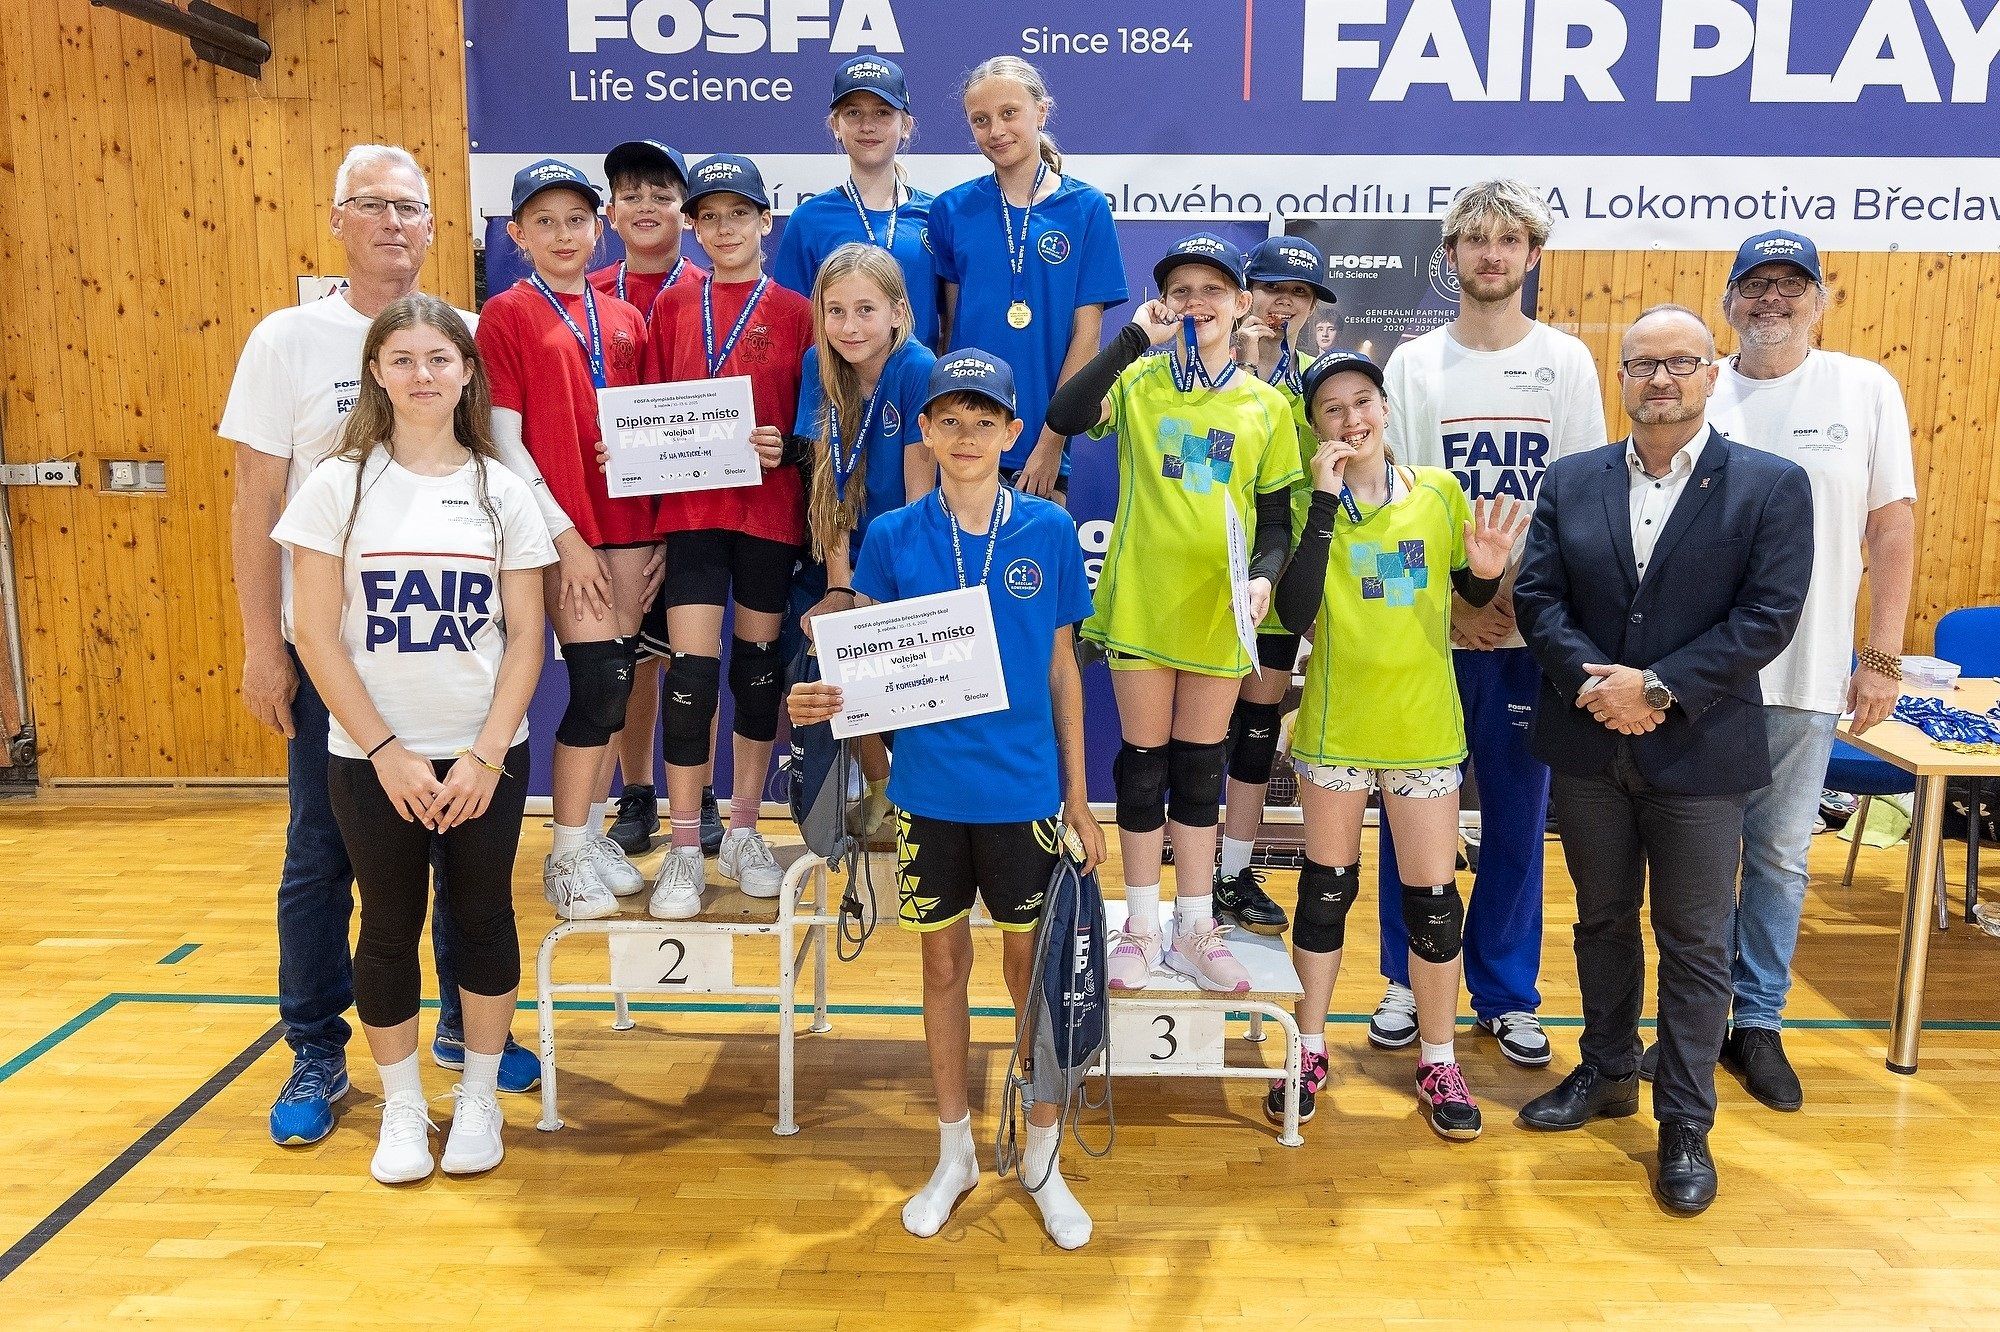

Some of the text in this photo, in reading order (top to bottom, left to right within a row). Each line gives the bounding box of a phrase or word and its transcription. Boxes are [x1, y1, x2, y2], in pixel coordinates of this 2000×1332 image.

[568, 0, 904, 54] FOSFA
[1021, 27, 1193, 54] Since 1884
[1302, 0, 2000, 104] FAIR PLAY
[847, 62, 891, 76] FOSFA
[570, 70, 793, 102] Life Science
[529, 164, 578, 179] FOSFA
[697, 162, 743, 178] FOSFA
[1105, 184, 1262, 212] alového
[1276, 184, 1411, 218] oddílu
[1586, 185, 1836, 221] Lokomotiva
[1178, 237, 1226, 252] FOSFA
[1754, 238, 1804, 251] FOSFA
[1763, 247, 1795, 256] Sport
[1279, 247, 1319, 266] FOSFA
[1287, 257, 1314, 270] Sport
[1329, 255, 1403, 269] FOSFA
[1329, 270, 1379, 279] Life Science
[1344, 315, 1383, 324] ČESKÉHO
[1385, 316, 1450, 324] OLYMPIJSKÉHO
[1365, 308, 1414, 316] GENERÁLNÍ
[943, 358, 996, 374] FOSFA
[951, 368, 986, 378] Sport
[616, 407, 740, 430] Diplom za 2. místo
[663, 428, 696, 437] Volejbal
[1441, 431, 1550, 469] FAIR
[1454, 469, 1544, 501] PLAY
[949, 511, 962, 557] řeclavských
[983, 539, 996, 577] olympiáda
[360, 569, 493, 614] FAIR
[366, 615, 491, 653] PLAY
[853, 622, 872, 630] FOSFA
[836, 625, 975, 660] Diplom za 1. místo
[890, 652, 927, 665] Volejbal
[885, 680, 894, 693] ZŠ
[847, 712, 870, 721] FOSFA
[657, 938, 689, 985] 2
[1149, 1014, 1177, 1061] 3
